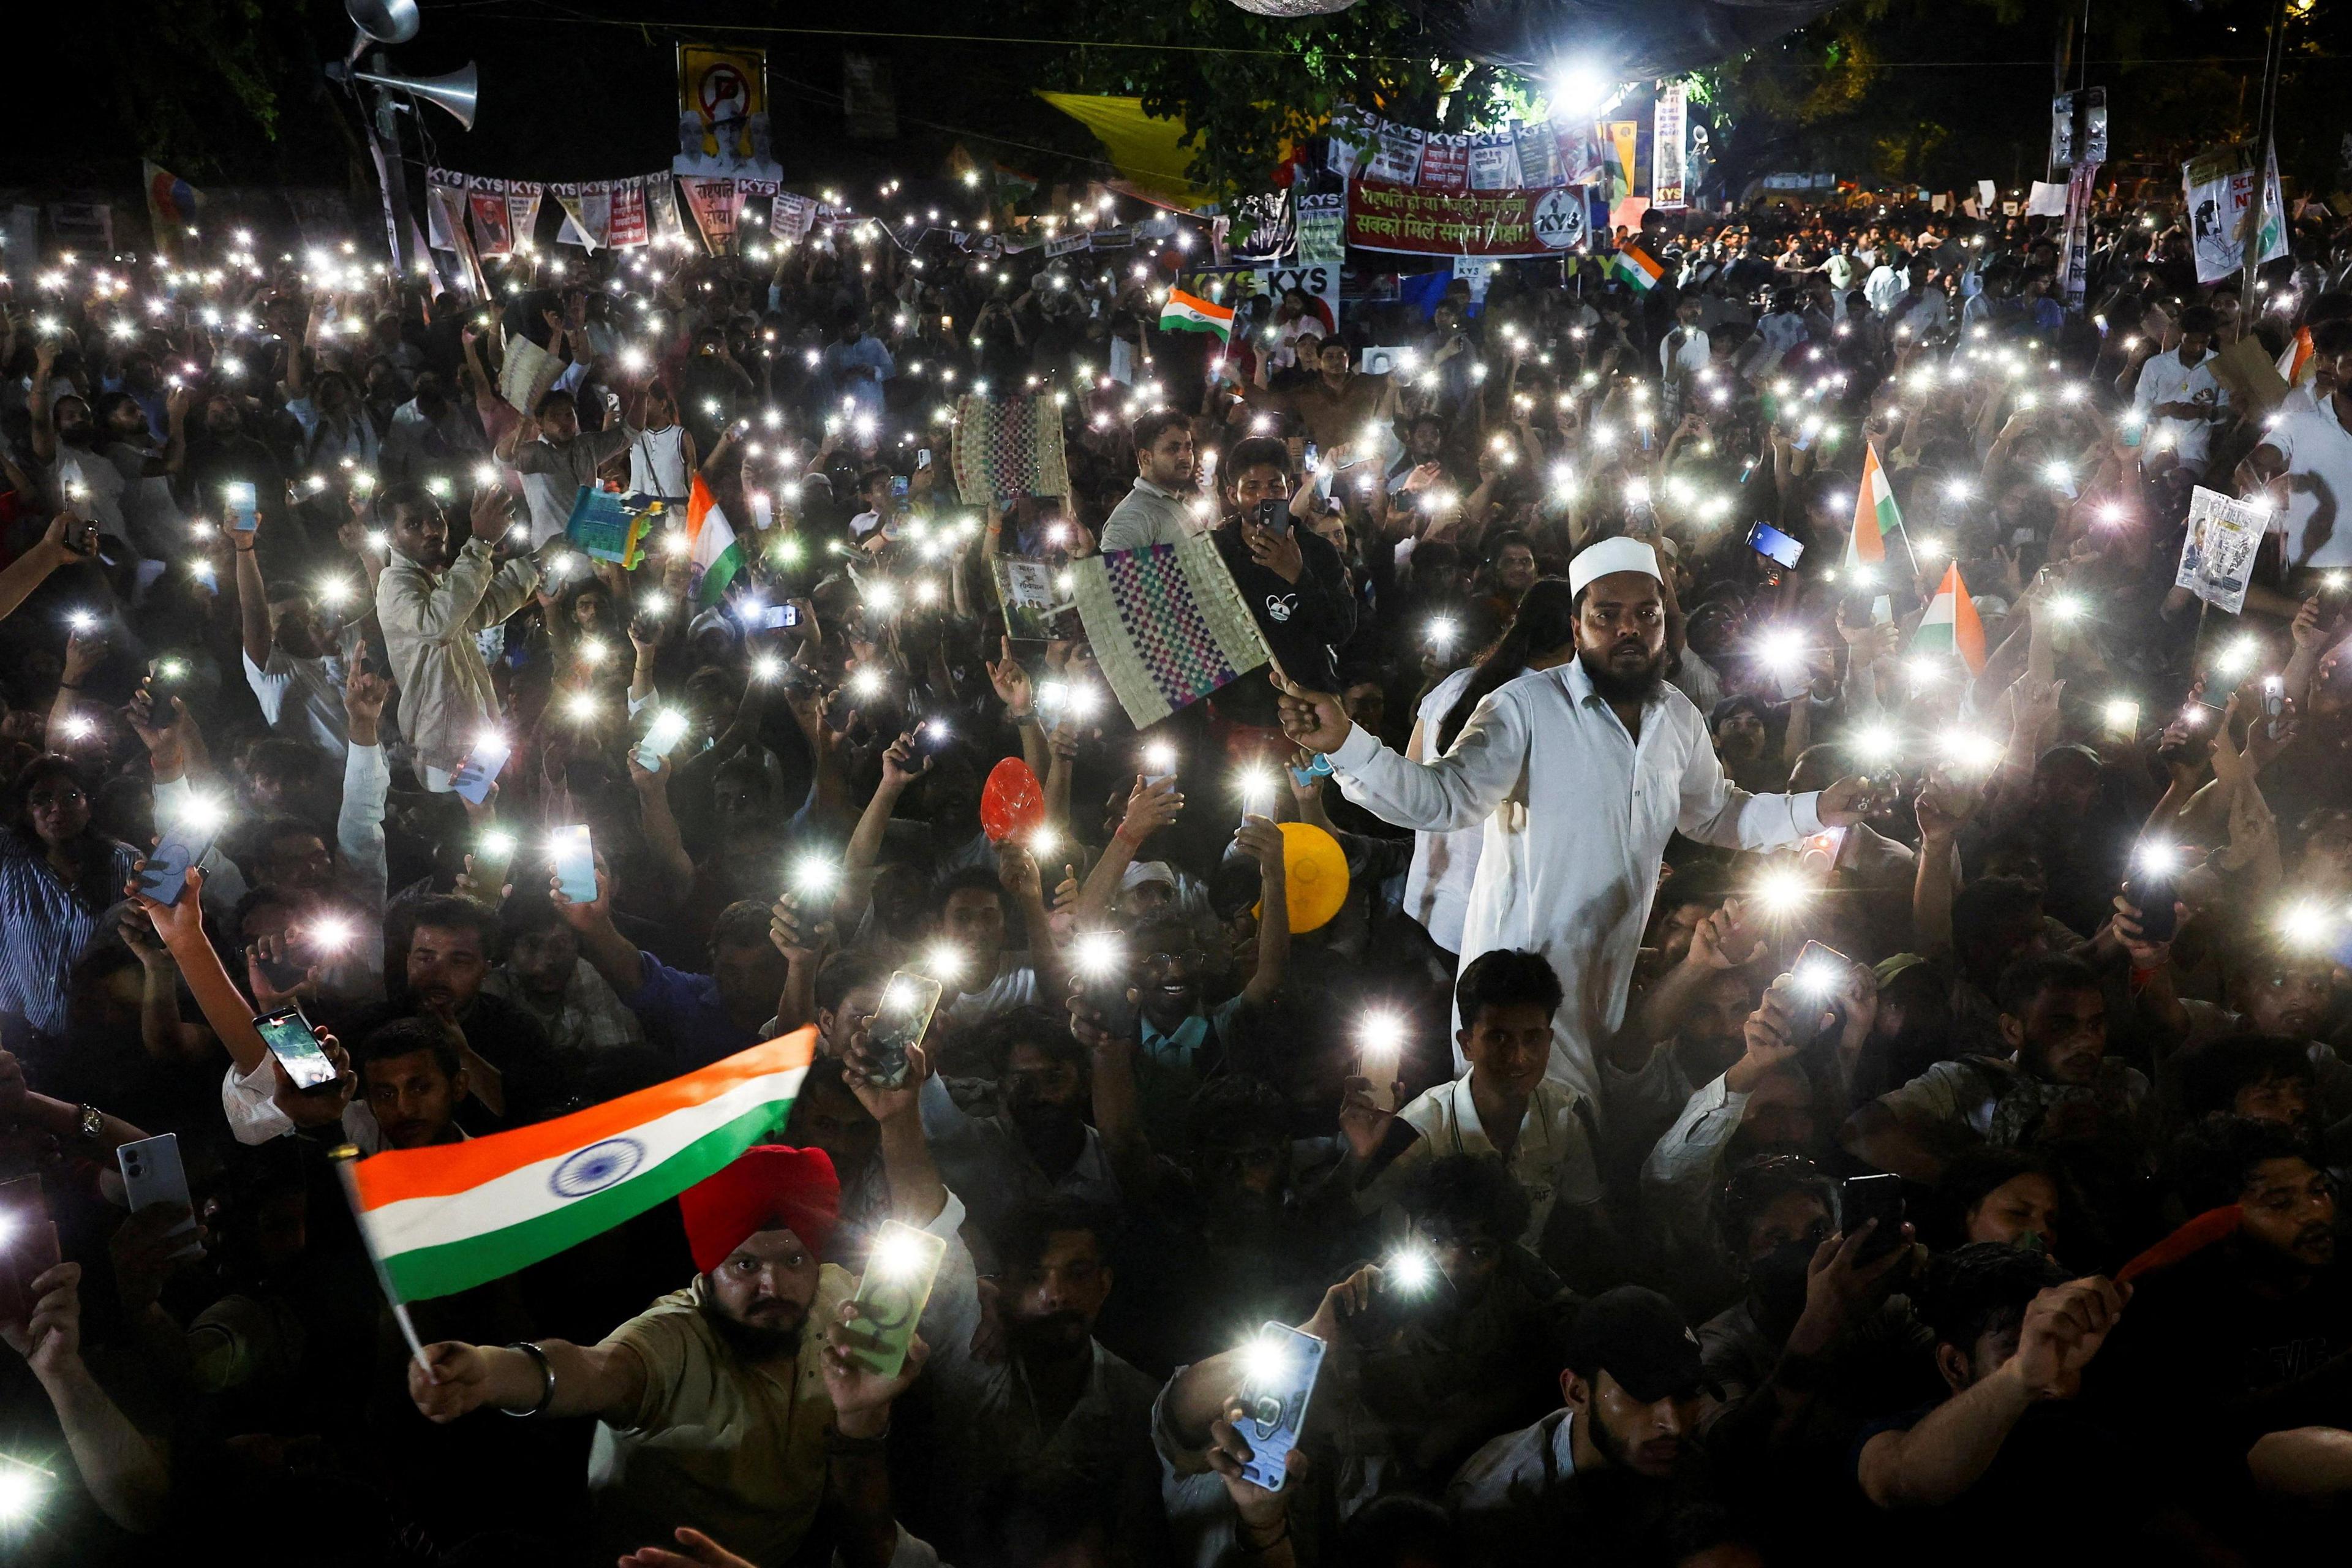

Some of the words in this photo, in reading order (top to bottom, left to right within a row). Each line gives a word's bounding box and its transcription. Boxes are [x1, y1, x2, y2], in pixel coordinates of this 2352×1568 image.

[1382, 120, 1423, 140] KYS
[1518, 124, 1550, 139] KYS
[1428, 132, 1467, 147] KYS
[1471, 134, 1512, 146] KYS
[429, 167, 462, 185] KYS
[647, 170, 669, 184] KYS
[469, 176, 503, 192] KYS
[511, 180, 542, 194] KYS
[582, 181, 609, 194] KYS
[613, 176, 641, 192] KYS
[740, 180, 777, 194] KYS
[1300, 194, 1338, 207] KYS
[1361, 187, 1404, 211] राष्ट्रपति
[1407, 190, 1420, 209] हो
[1423, 197, 1438, 211] या
[1656, 187, 1682, 201] KYS
[1354, 212, 1402, 236] सबको
[1540, 212, 1580, 232] KYS
[1268, 268, 1327, 297] KYS
